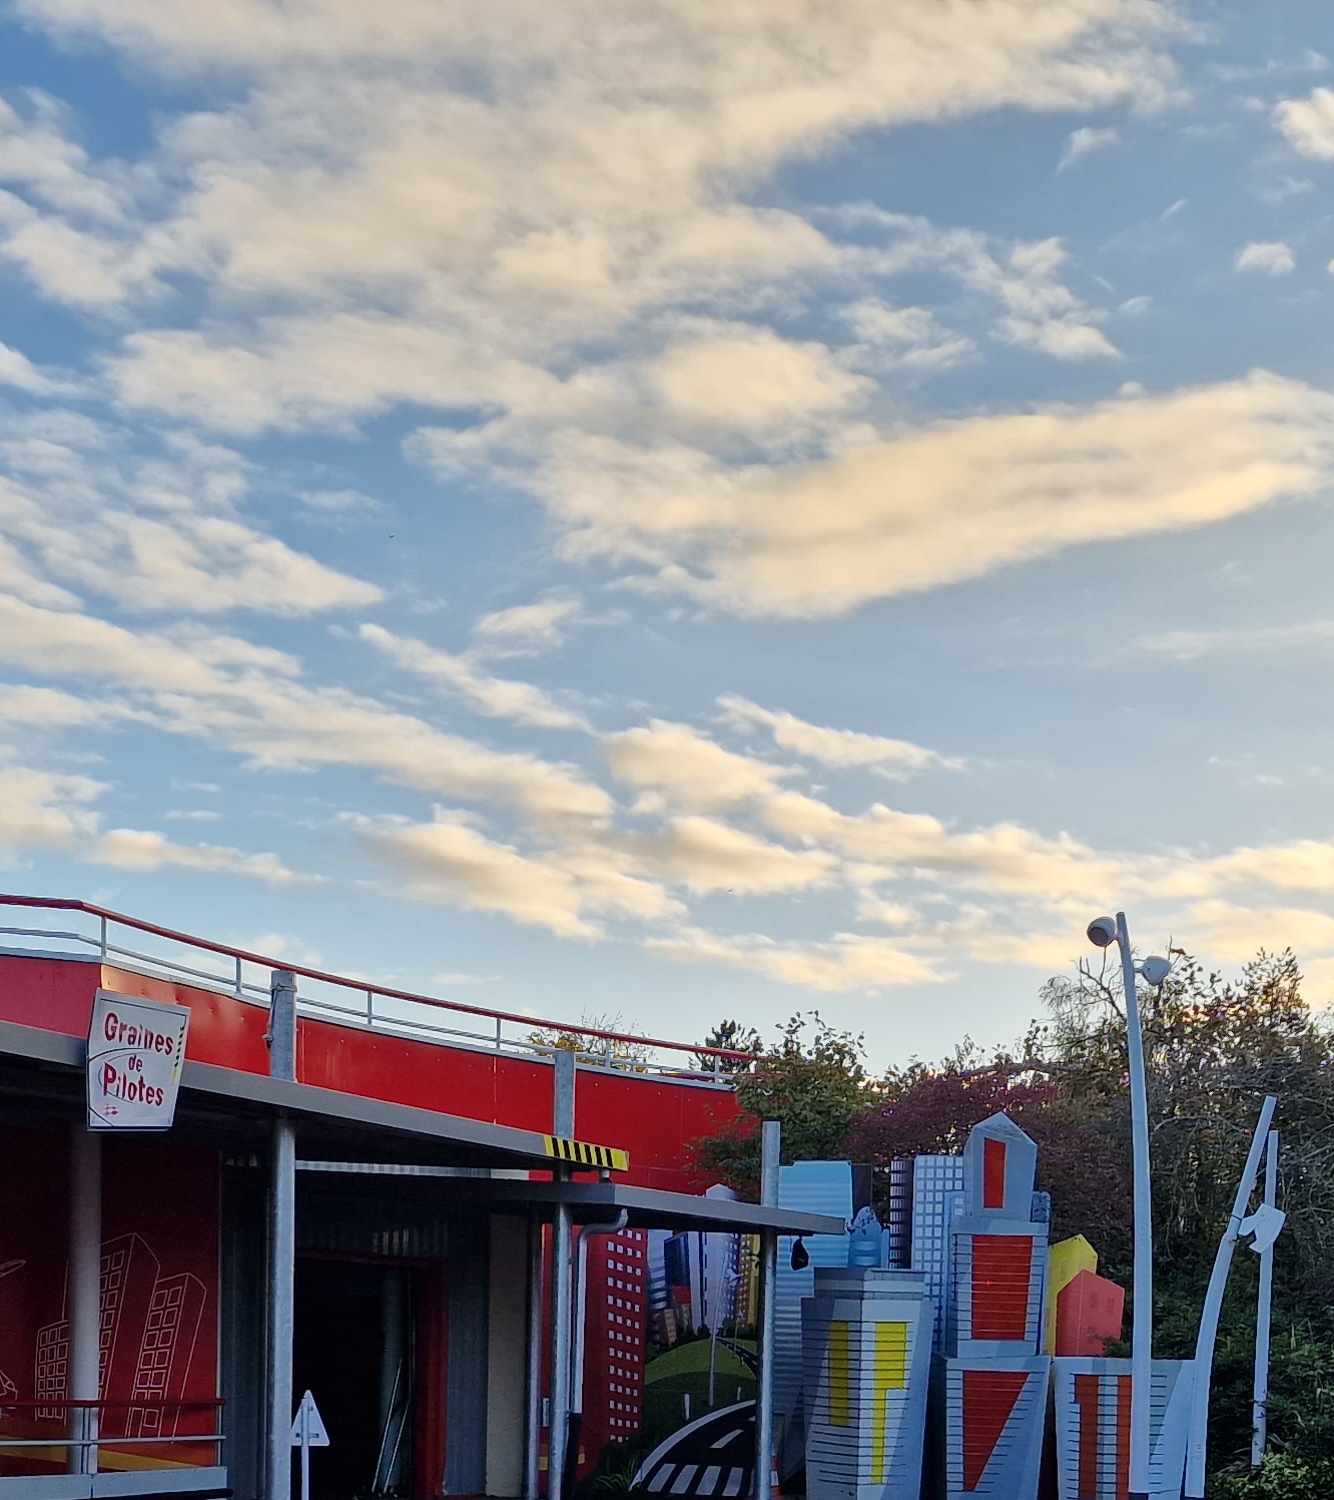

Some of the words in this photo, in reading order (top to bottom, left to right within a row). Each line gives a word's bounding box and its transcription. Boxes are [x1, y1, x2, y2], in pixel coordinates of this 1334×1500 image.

[104, 1012, 174, 1056] Graines
[103, 1062, 164, 1106] Pilotes
[128, 1054, 143, 1073] de
